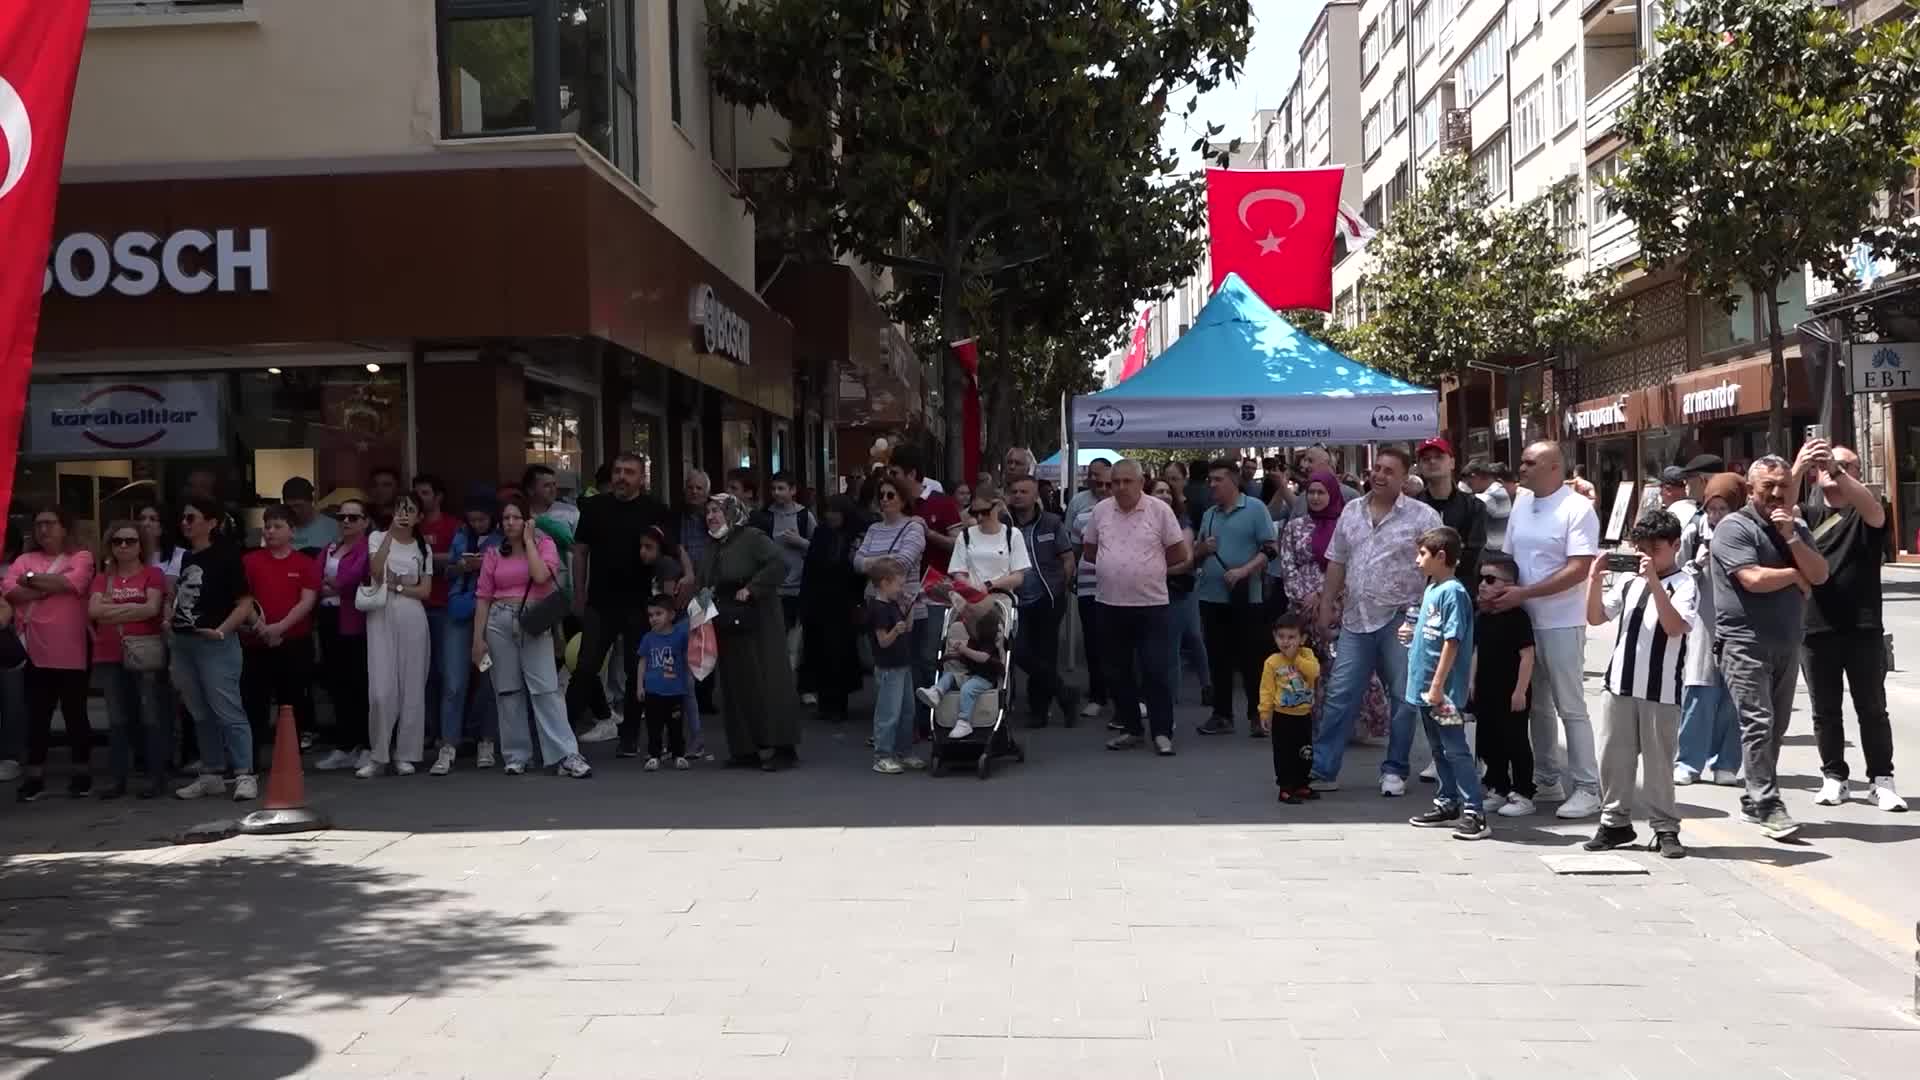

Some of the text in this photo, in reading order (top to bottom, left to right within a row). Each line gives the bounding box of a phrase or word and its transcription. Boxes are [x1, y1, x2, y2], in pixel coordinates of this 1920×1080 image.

[717, 301, 750, 366] BOSCH
[1863, 370, 1912, 388] EBT
[1683, 379, 1741, 416] armando
[1378, 413, 1424, 423] 444 40 10
[1167, 427, 1215, 439] BALIKESİR
[1278, 426, 1331, 438] BELEDİYESİ
